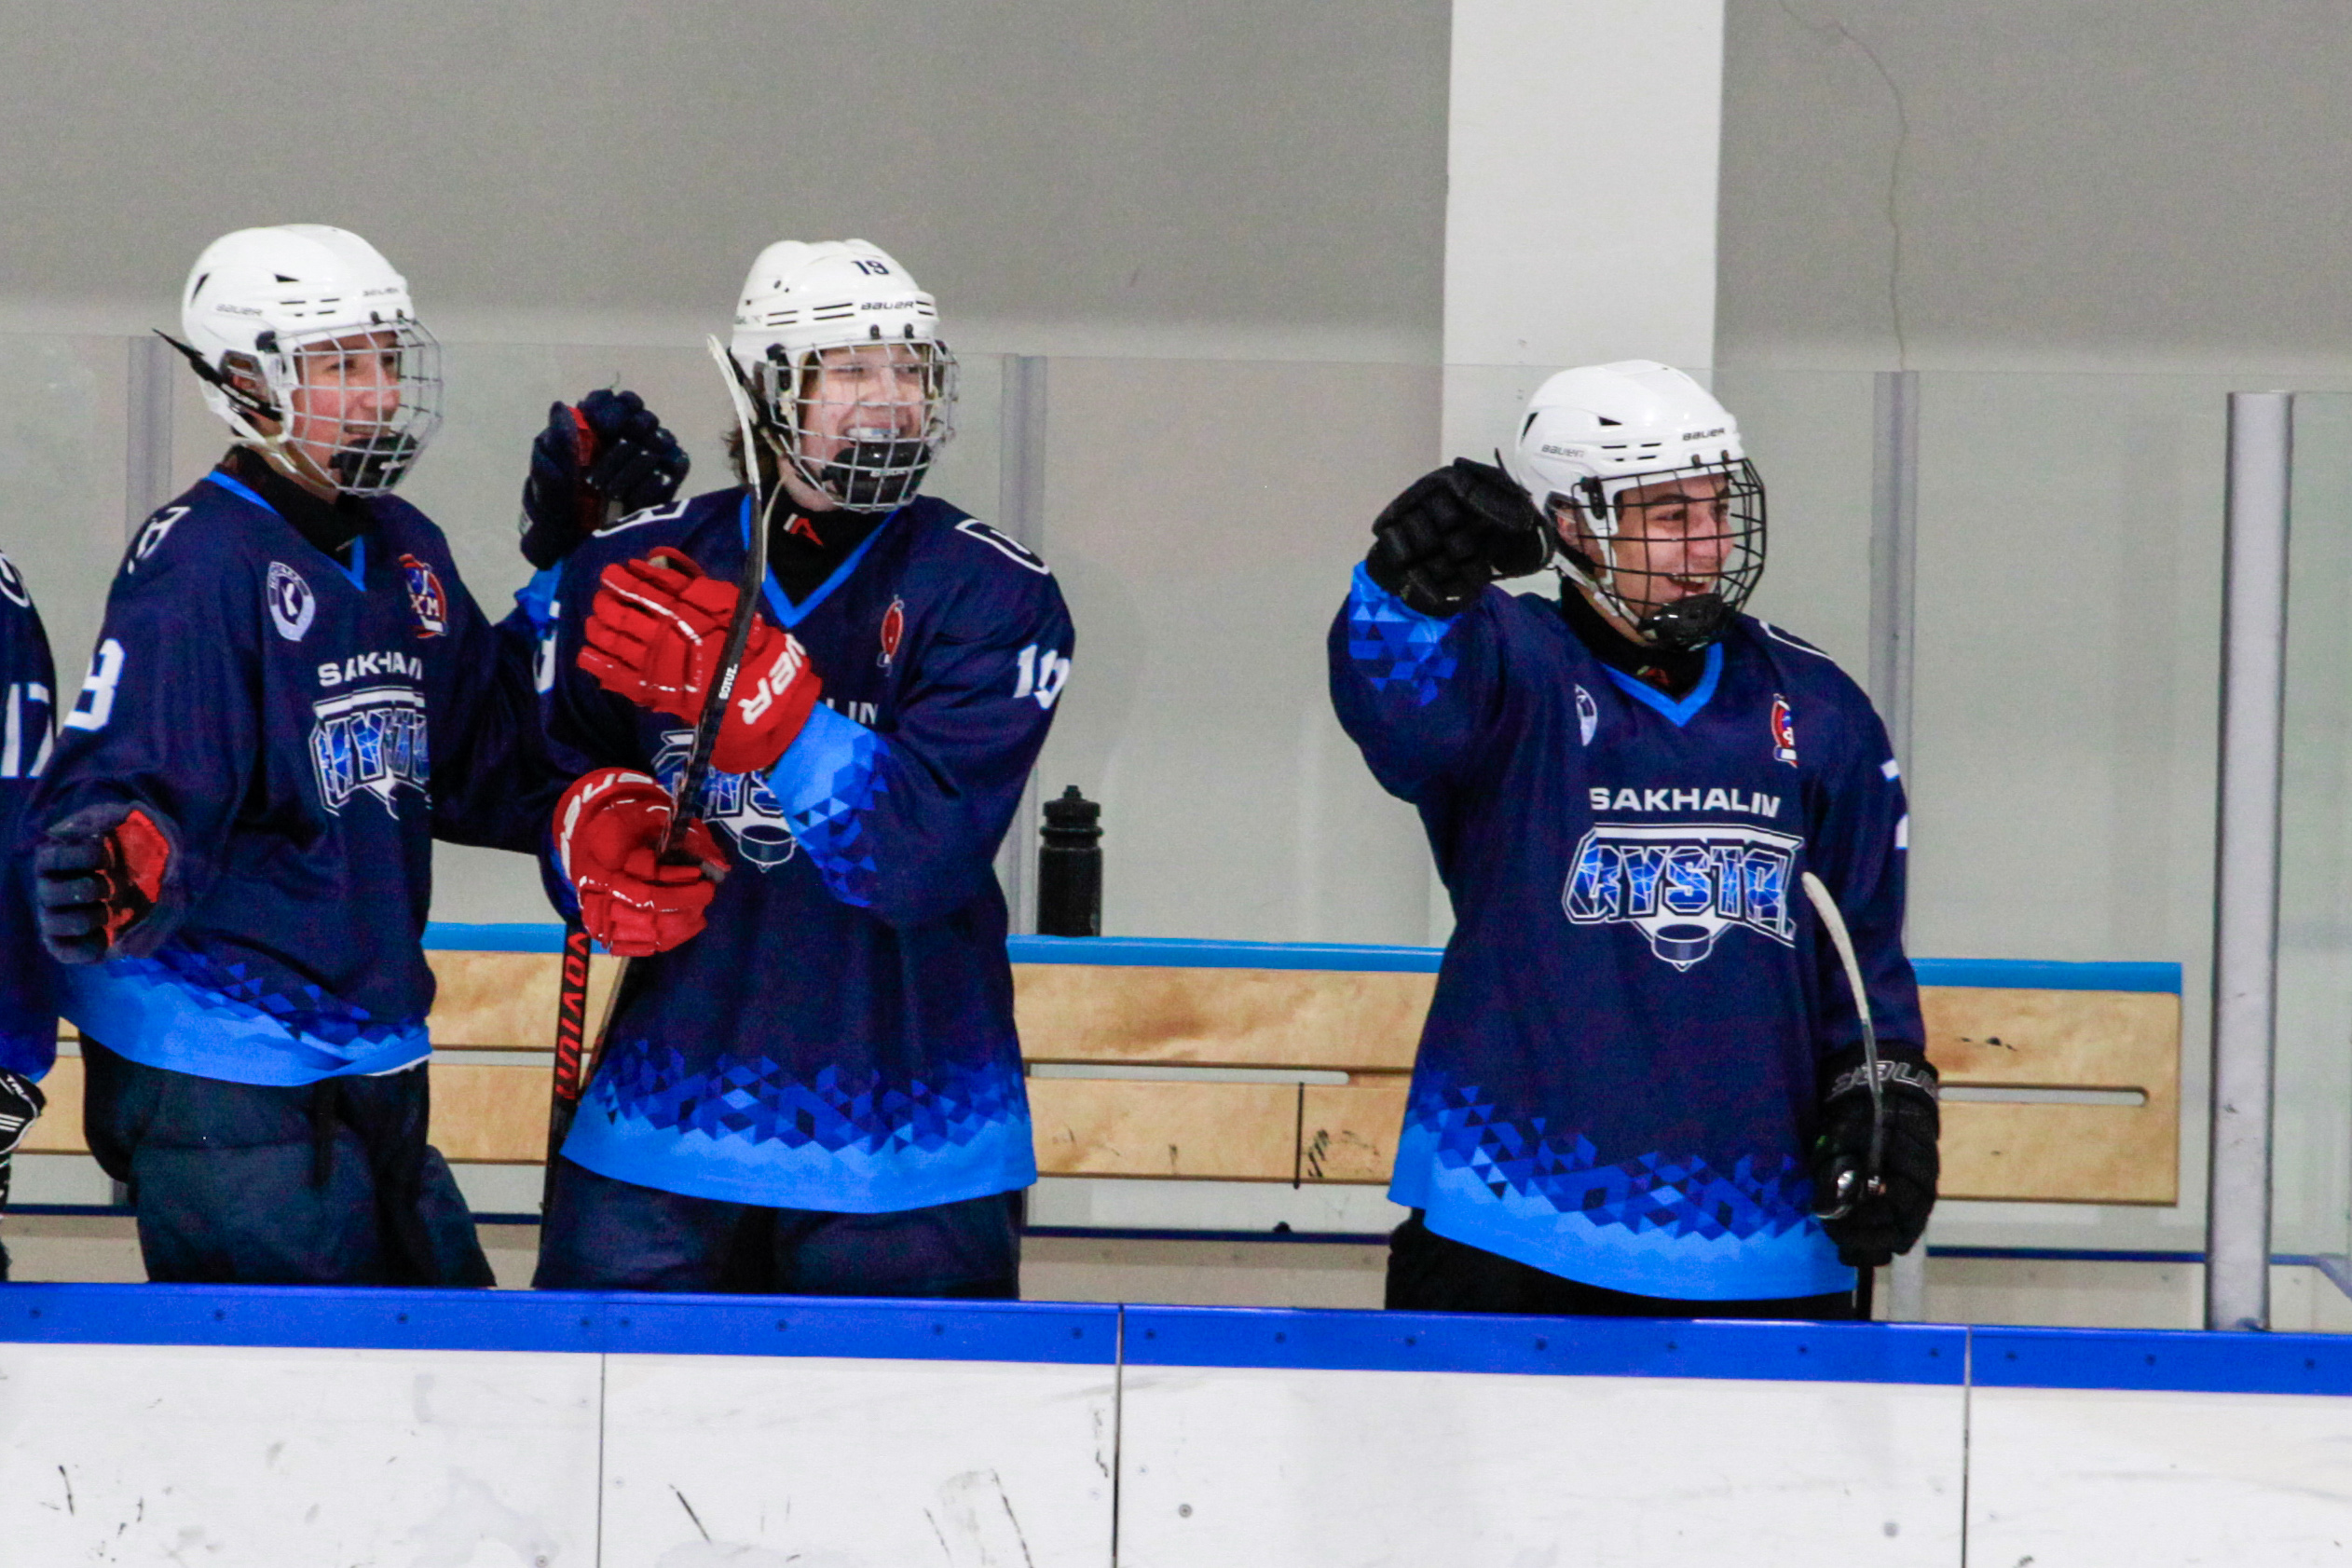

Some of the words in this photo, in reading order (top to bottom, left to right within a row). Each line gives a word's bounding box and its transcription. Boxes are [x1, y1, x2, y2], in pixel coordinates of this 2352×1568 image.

[850, 259, 889, 276] 19
[860, 300, 916, 311] BAUER
[1681, 428, 1726, 442] BAUER
[1540, 443, 1585, 458] BAUER
[1589, 787, 1781, 818] SAKHALIN
